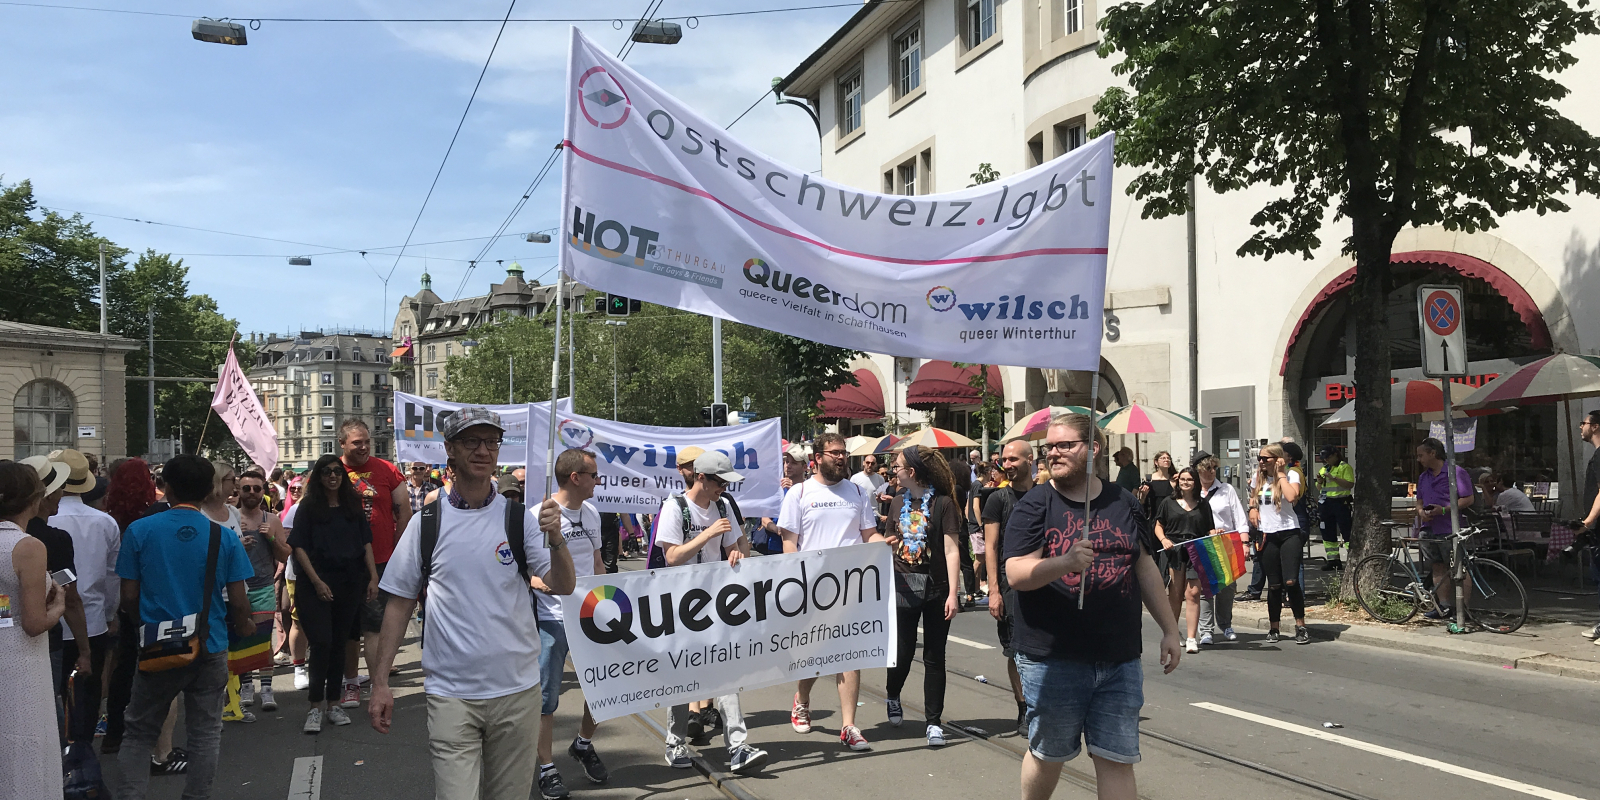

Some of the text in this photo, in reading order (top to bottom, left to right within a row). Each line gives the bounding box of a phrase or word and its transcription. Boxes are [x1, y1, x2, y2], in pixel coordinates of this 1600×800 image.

[647, 108, 1096, 230] ostschweiz.lgbt
[572, 206, 660, 267] HOT
[652, 263, 719, 285] For Gays & Friends
[667, 248, 726, 274] THURGAU
[743, 258, 907, 324] Queerdom
[739, 288, 907, 338] queere Vielfalt in Schaffhausen
[957, 294, 1090, 321] wilsch
[960, 327, 1077, 344] queer Winterthur
[600, 475, 648, 491] queer
[811, 500, 854, 508] Queerdom
[580, 561, 882, 644] Queerdom
[584, 619, 883, 688] queere Vielfalt in Schaffhausen
[788, 646, 885, 672] info@queerdom.ch
[589, 680, 700, 711] www.queerdom.ch
